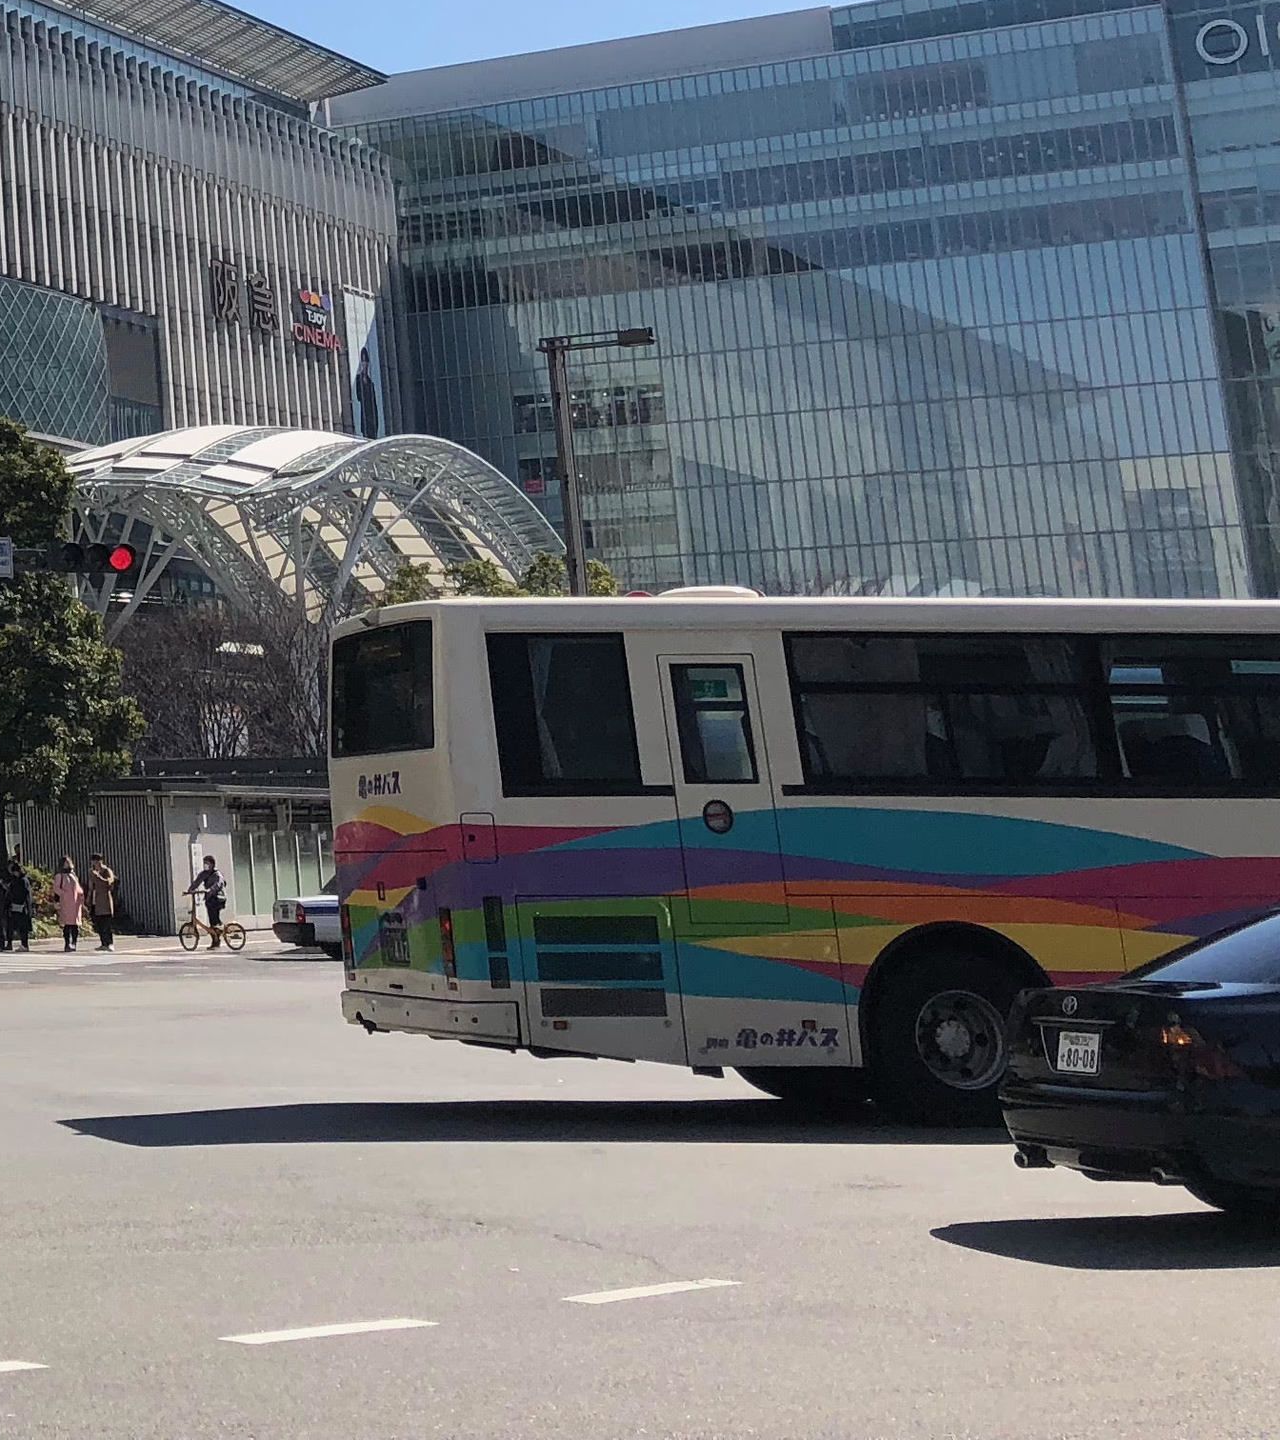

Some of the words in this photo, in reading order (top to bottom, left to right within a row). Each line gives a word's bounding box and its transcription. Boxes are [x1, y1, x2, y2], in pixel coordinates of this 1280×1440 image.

[292, 322, 343, 352] CINEMA
[736, 1028, 839, 1049] 亀の井バス
